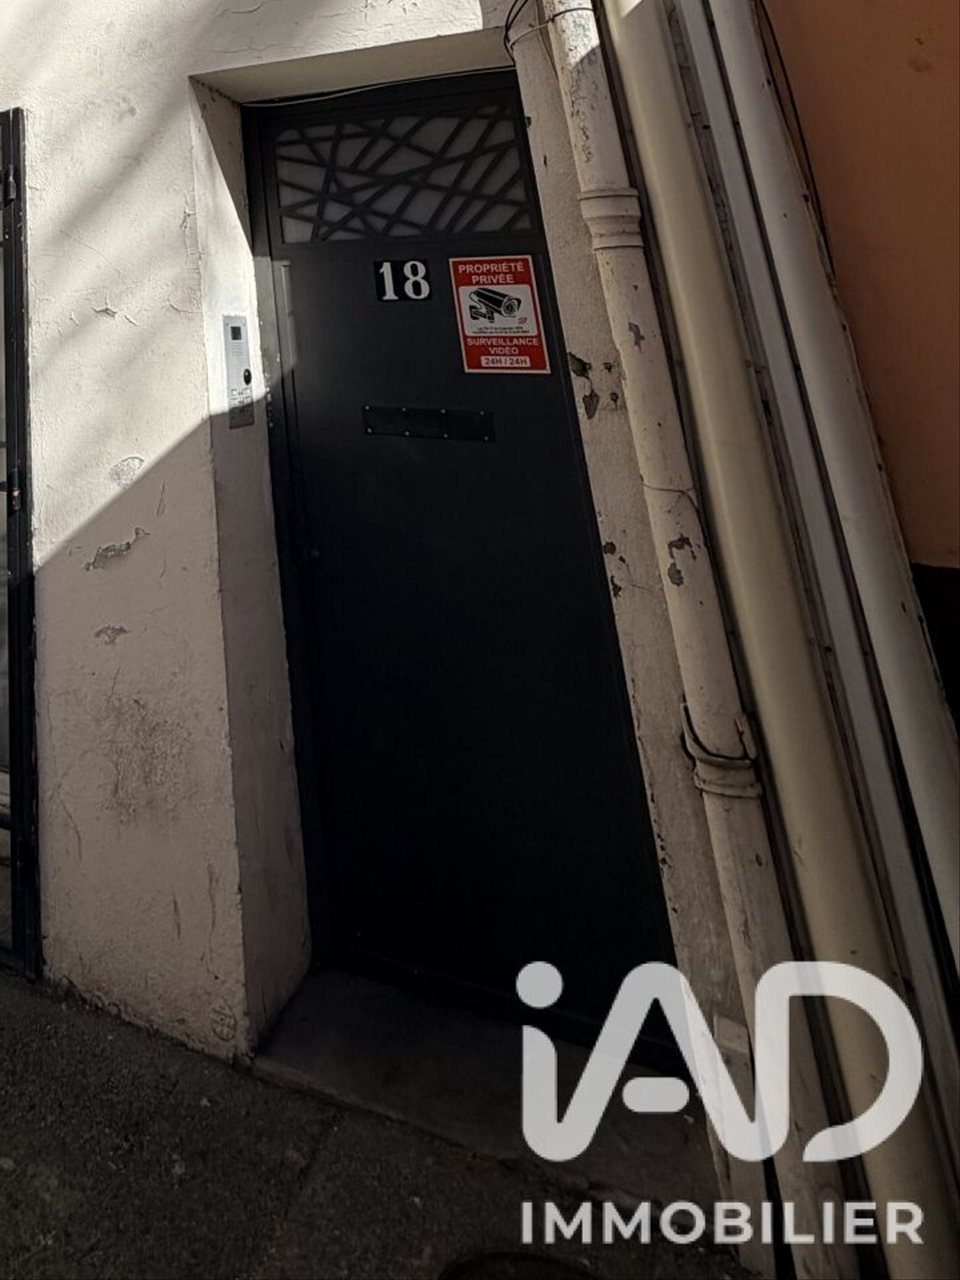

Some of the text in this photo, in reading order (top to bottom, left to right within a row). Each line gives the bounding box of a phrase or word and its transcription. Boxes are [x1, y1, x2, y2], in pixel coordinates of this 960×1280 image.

[458, 262, 525, 274] PROPRIÉTÉ
[379, 261, 430, 300] 18
[471, 274, 515, 284] PRIVÉE
[466, 337, 539, 346] SURVEILLANCE
[488, 346, 519, 355] VIDÉO
